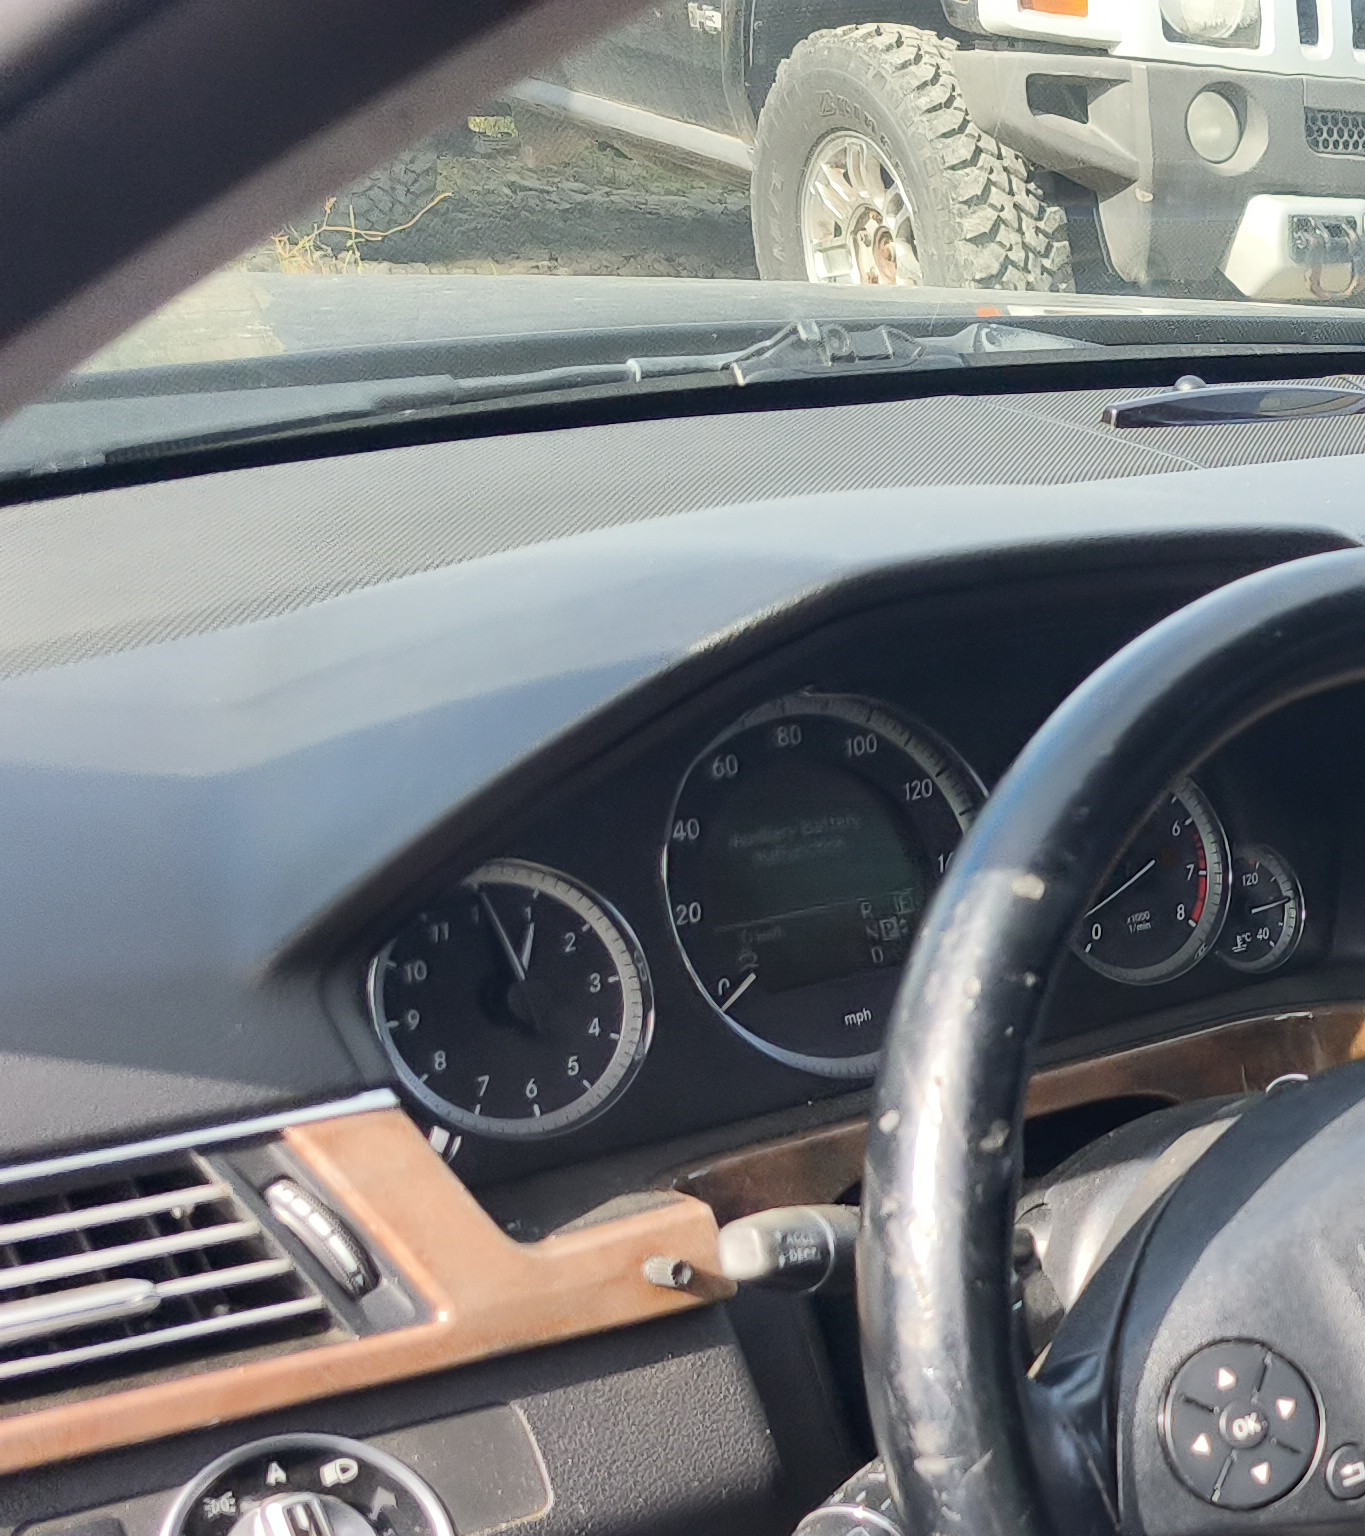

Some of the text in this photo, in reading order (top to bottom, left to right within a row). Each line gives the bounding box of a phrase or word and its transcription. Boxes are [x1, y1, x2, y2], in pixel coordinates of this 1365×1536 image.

[776, 724, 802, 747] 80
[845, 733, 878, 757] 100
[709, 754, 739, 779] 60
[904, 778, 933, 802] 120
[672, 817, 700, 842] 40
[1171, 820, 1181, 837] 6
[1185, 863, 1195, 881] 7
[1241, 872, 1258, 887] 120
[676, 900, 702, 926] 20
[1176, 903, 1185, 921] 8
[429, 920, 450, 944] 11
[564, 931, 577, 954] 2
[1091, 923, 1102, 941] 0
[1256, 926, 1270, 940] 40
[403, 958, 428, 984] 10
[588, 971, 602, 994] 3
[406, 1008, 421, 1031] 9
[588, 1016, 600, 1037] 4
[843, 1008, 872, 1027] mph
[434, 1049, 447, 1071] 8
[567, 1055, 579, 1076] 5
[477, 1074, 490, 1097] 7
[525, 1077, 538, 1098] 6
[1231, 1411, 1262, 1441] OK
[265, 1460, 288, 1487] A
